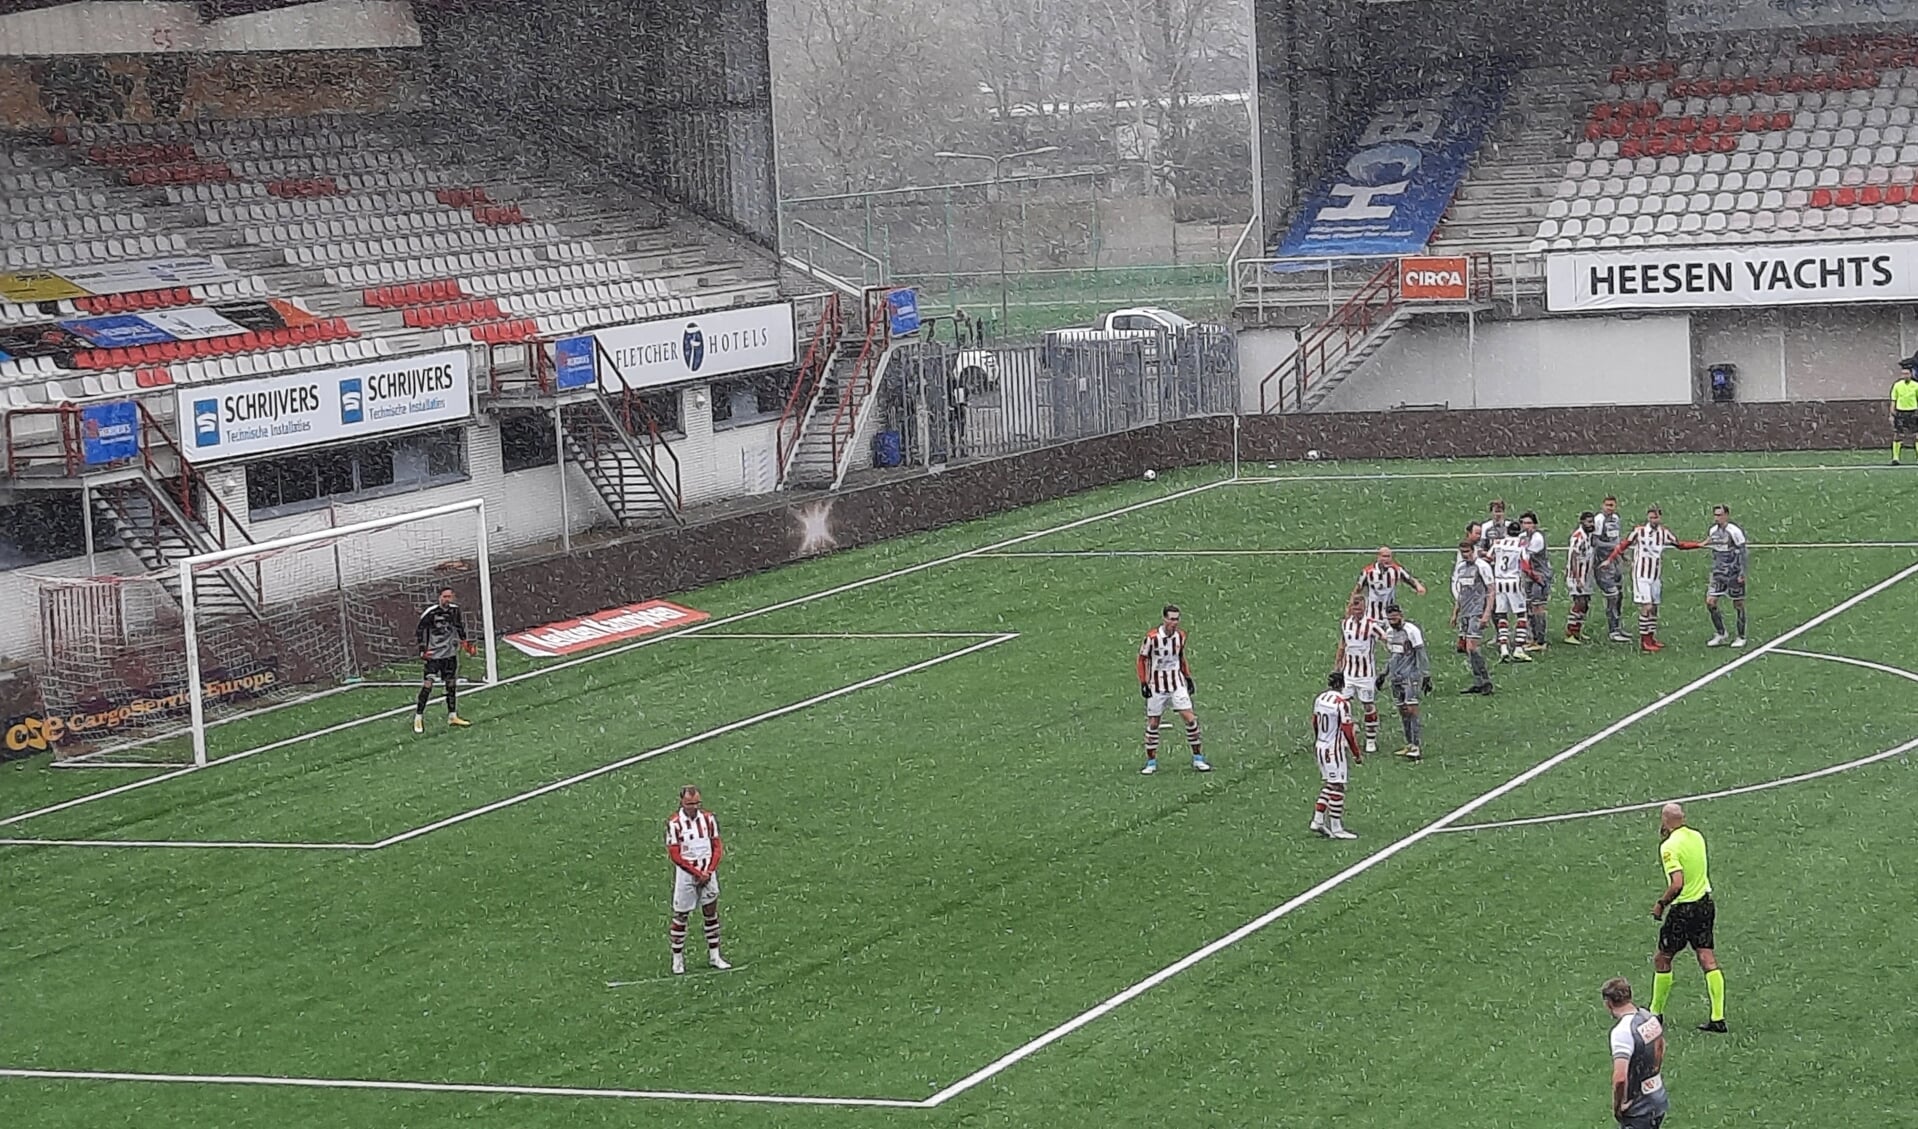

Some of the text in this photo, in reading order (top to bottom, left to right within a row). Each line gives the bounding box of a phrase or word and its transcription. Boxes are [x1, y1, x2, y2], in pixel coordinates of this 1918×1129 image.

[1405, 270, 1463, 287] CIRCA
[1590, 255, 1893, 296] HEESEN YACHTS
[615, 341, 679, 370] FLETCHER
[708, 327, 768, 355] HOTELS
[368, 363, 453, 401] SCHRIJVERS
[225, 384, 320, 423] SCHRIJVERS
[1500, 555, 1510, 573] 3
[205, 670, 275, 697] Europe
